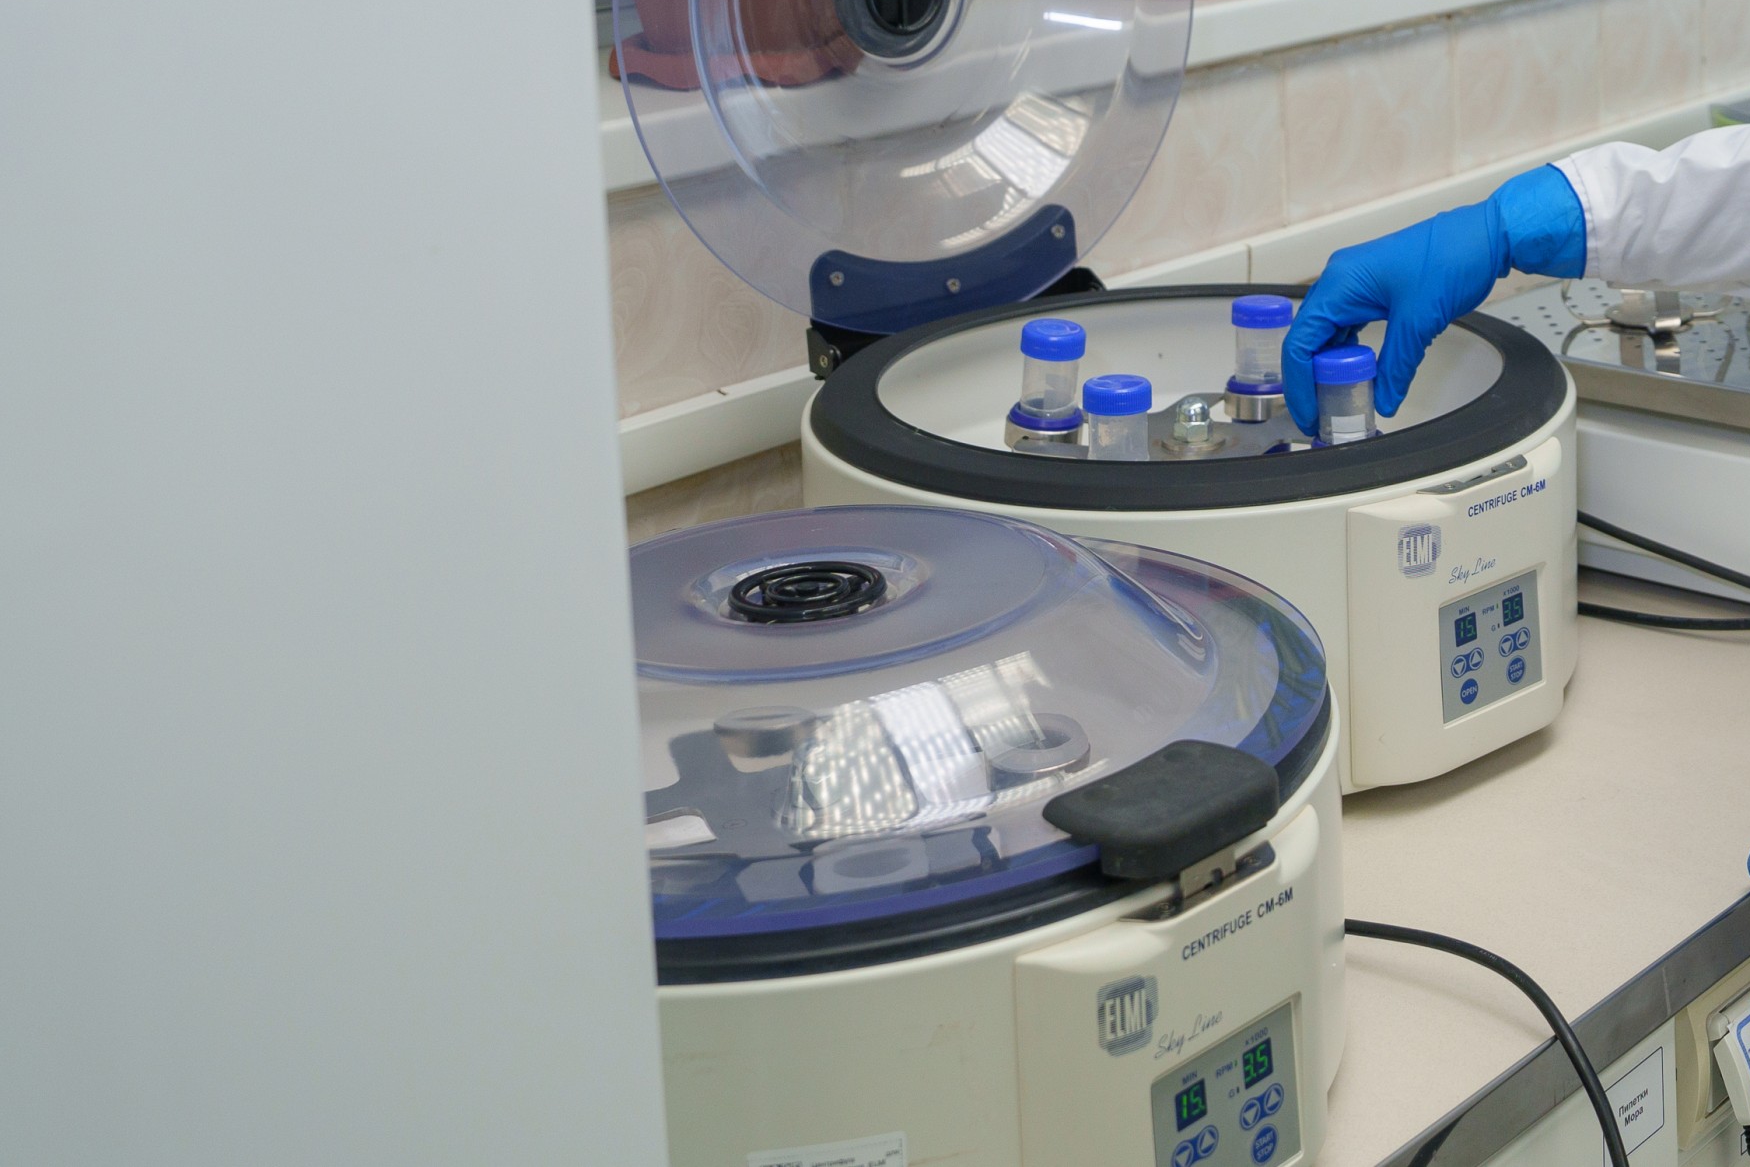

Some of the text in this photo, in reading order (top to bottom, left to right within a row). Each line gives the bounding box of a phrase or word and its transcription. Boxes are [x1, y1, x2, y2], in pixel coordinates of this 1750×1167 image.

[1467, 479, 1547, 518] CENTRIFUGE CM-6M
[1402, 533, 1433, 567] ELMI
[1448, 556, 1496, 585] Sky Line
[1458, 606, 1470, 616] MIN
[1482, 605, 1495, 616] RPM
[1509, 661, 1523, 673] START
[1510, 669, 1523, 680] STOP
[1461, 684, 1477, 698] OPEN
[1181, 886, 1294, 961] CENTRIFUGE CM-6M
[1103, 988, 1148, 1042] ELMI
[1154, 1011, 1223, 1059] Sky Line
[1182, 1070, 1198, 1085] MIN
[1215, 1061, 1233, 1079] RPM
[1618, 1087, 1649, 1118] Пипетки
[1624, 1105, 1644, 1128] Мора
[1255, 1132, 1275, 1150] START
